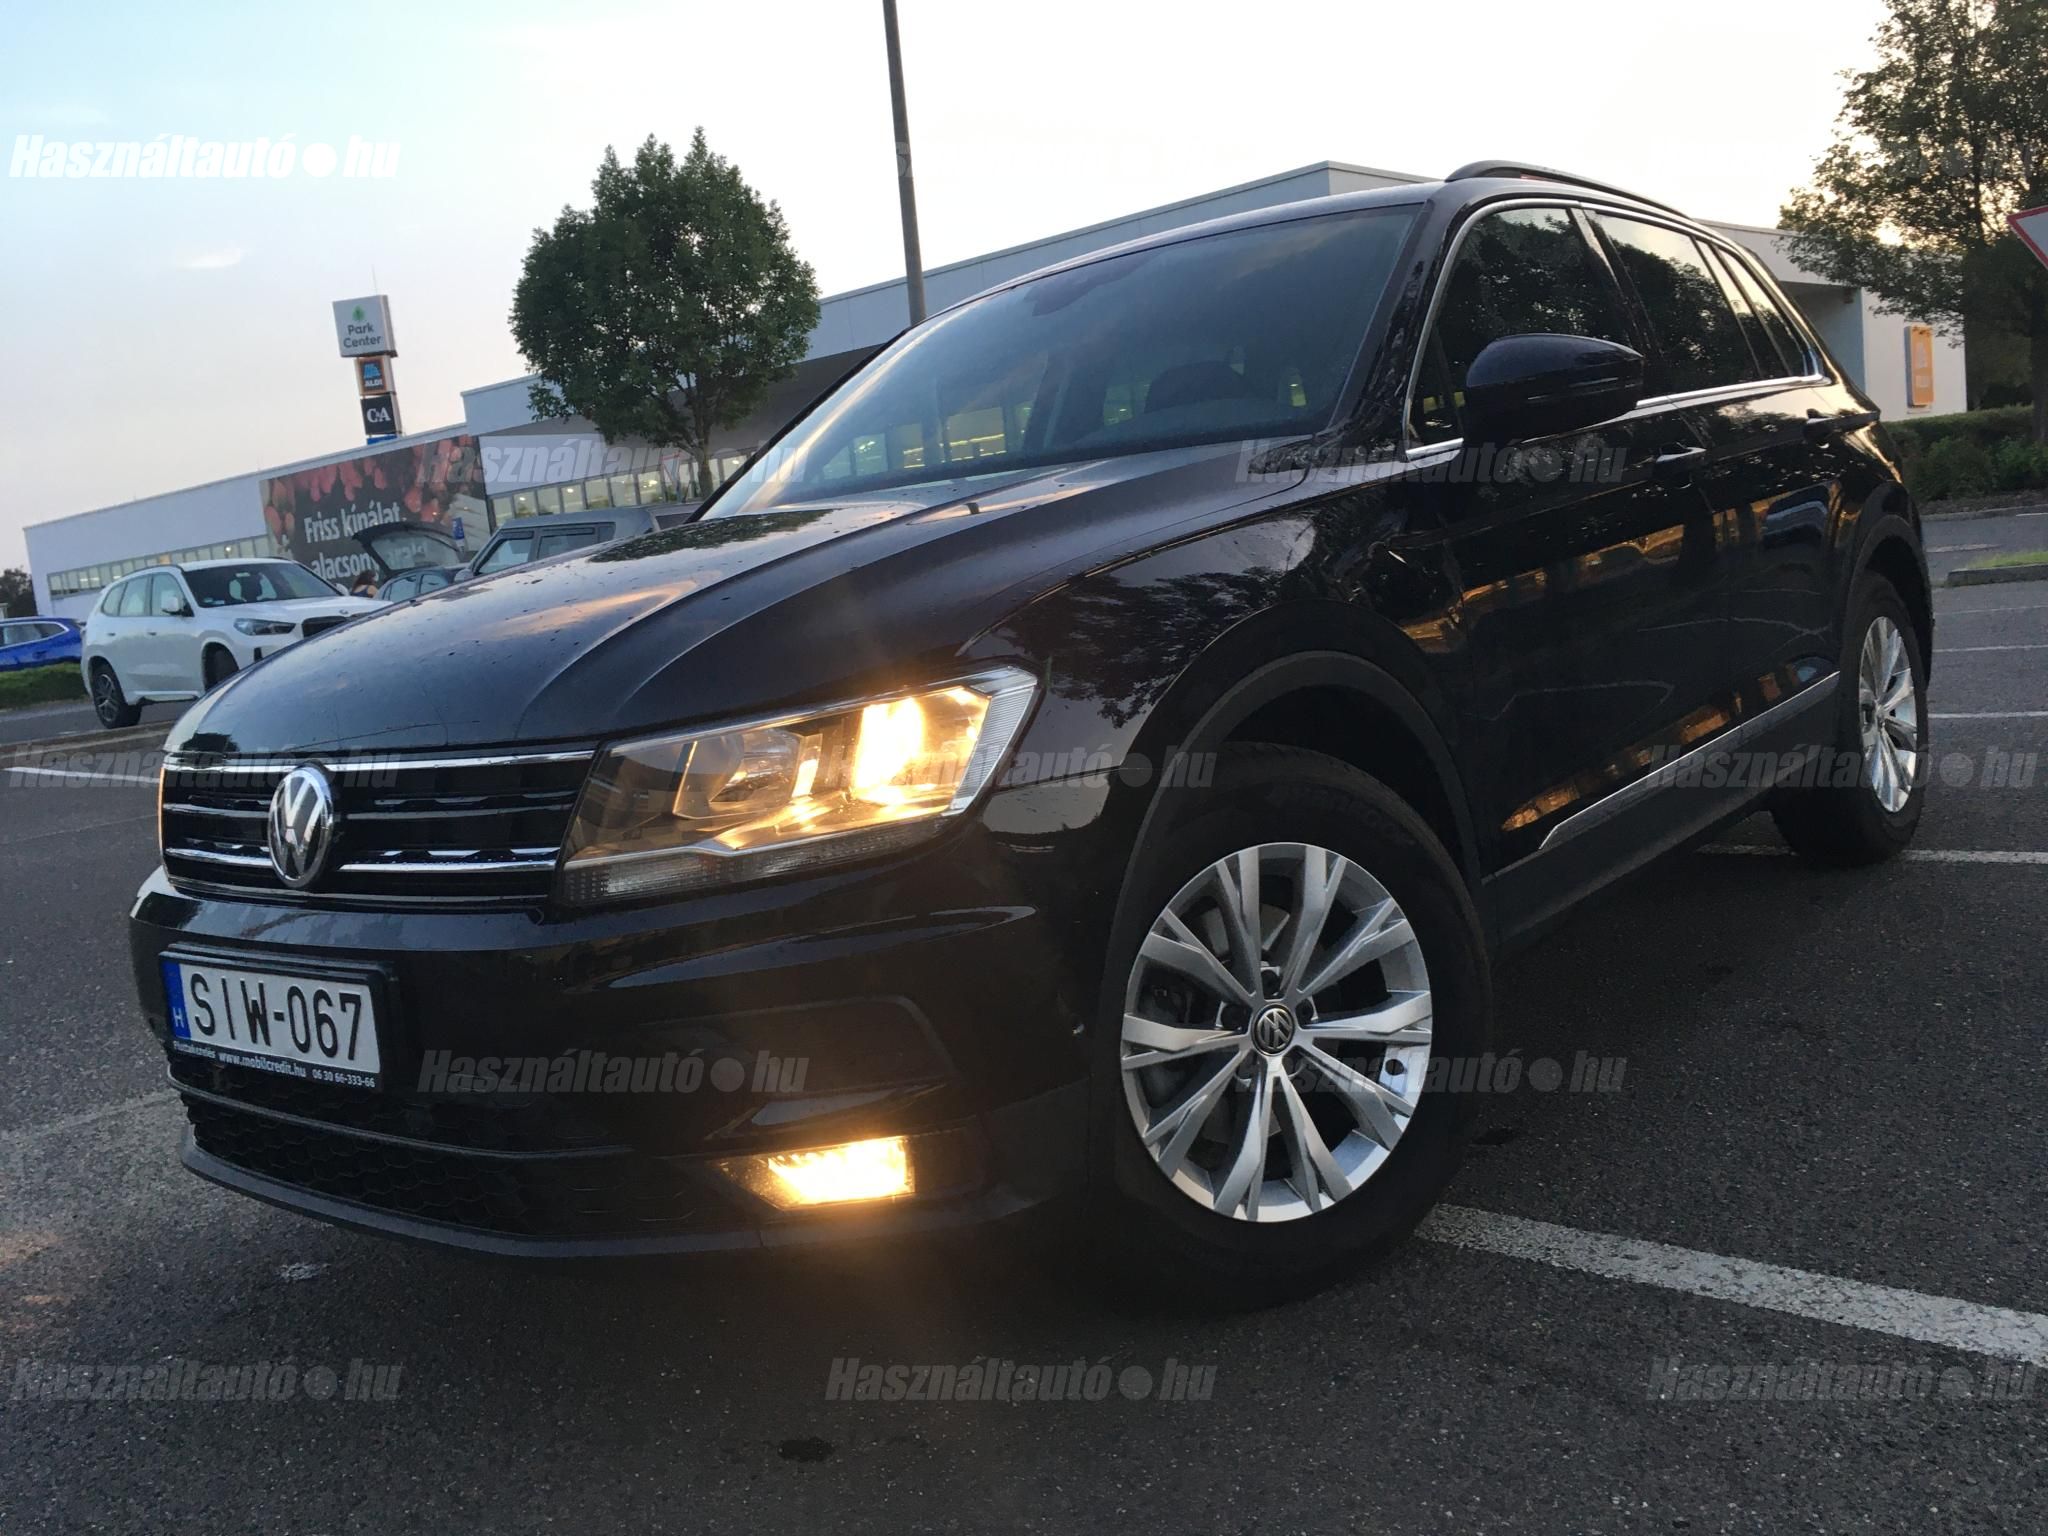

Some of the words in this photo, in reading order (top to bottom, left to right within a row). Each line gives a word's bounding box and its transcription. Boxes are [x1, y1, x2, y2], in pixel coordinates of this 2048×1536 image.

[347, 322, 374, 336] Park
[343, 335, 382, 348] Center
[364, 378, 383, 387] ALDI
[366, 407, 391, 423] C&A
[304, 511, 341, 543] Friss
[341, 500, 400, 537] kínálat
[311, 552, 380, 581] alacsony
[172, 1007, 185, 1029] H
[190, 972, 362, 1061] SIW-067
[312, 1068, 322, 1079] 06
[322, 1070, 334, 1082] 30
